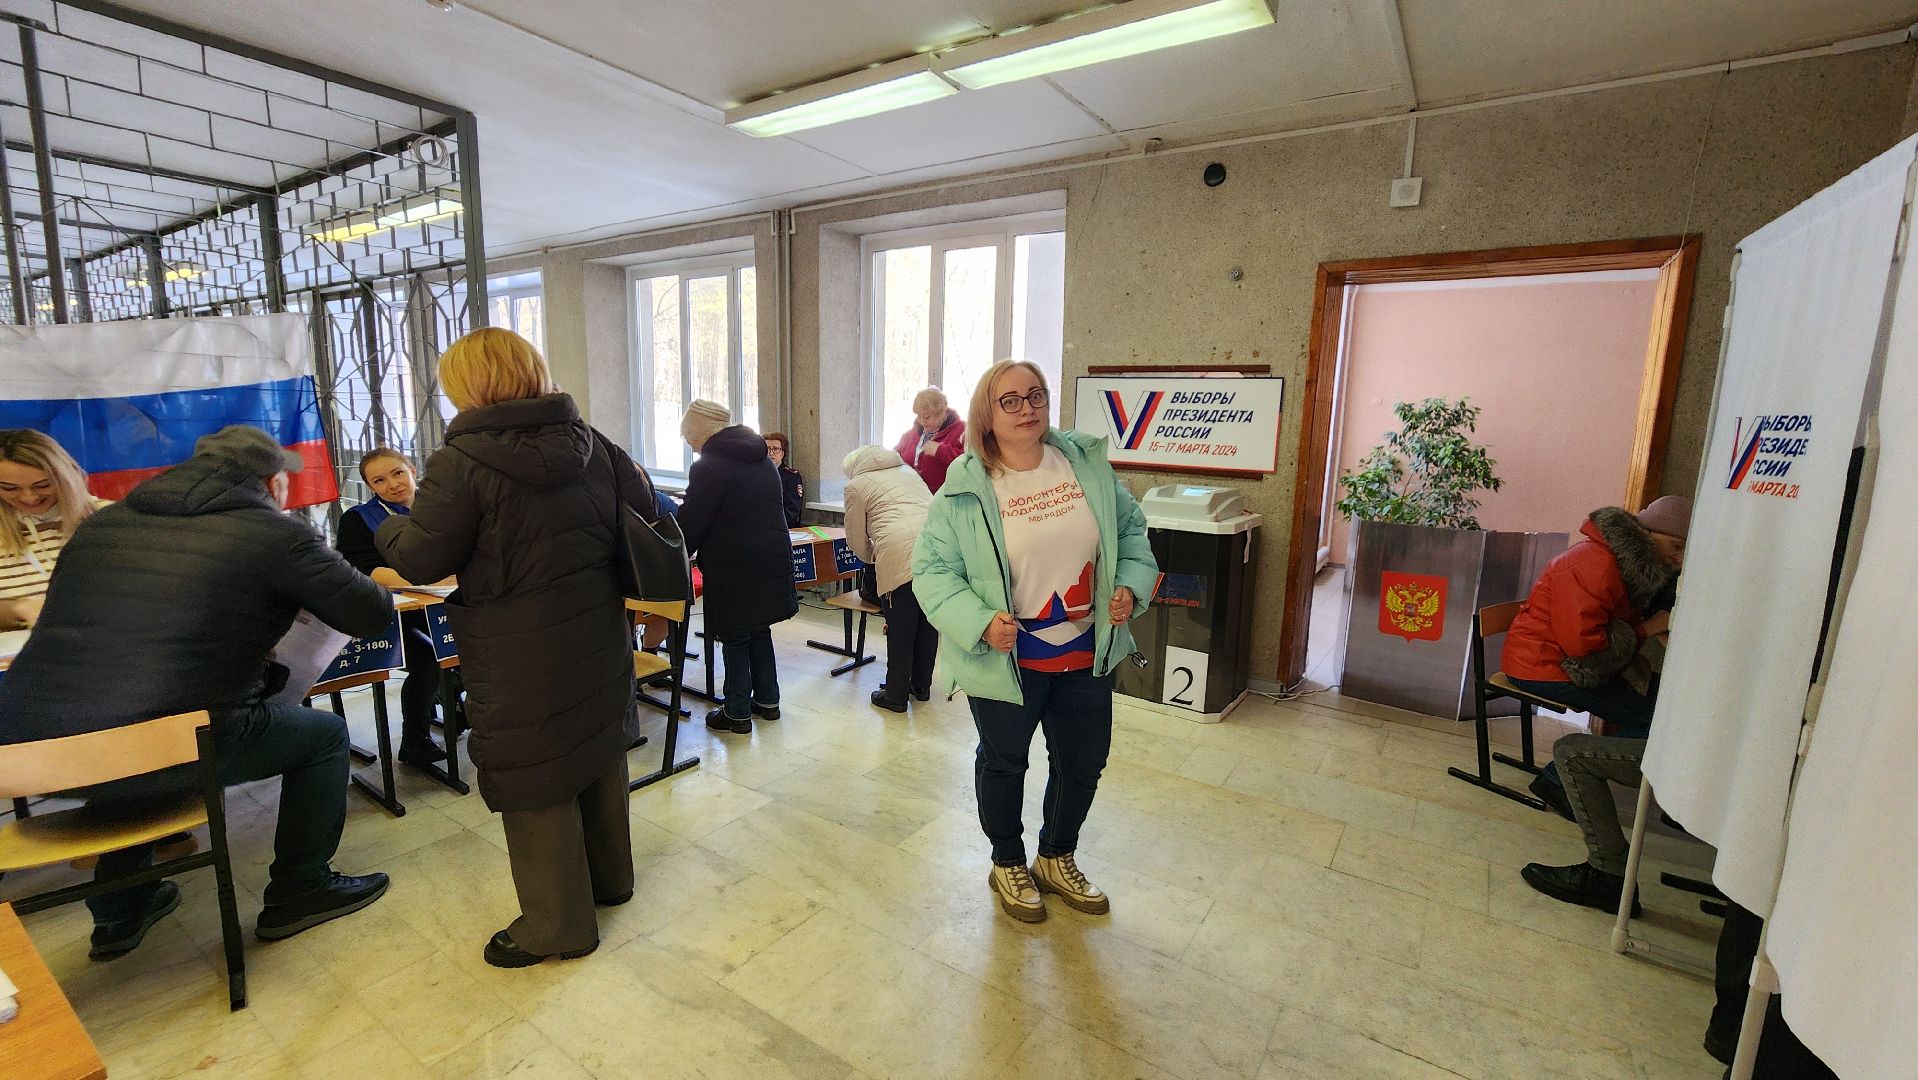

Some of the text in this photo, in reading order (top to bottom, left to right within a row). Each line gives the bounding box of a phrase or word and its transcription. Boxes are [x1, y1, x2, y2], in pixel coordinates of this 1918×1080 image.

[1170, 391, 1236, 405] ВЫБОРЫ
[1162, 408, 1254, 424] ПРЕЗИДЕНТА
[1154, 425, 1213, 440] РОССИИ
[1176, 442, 1211, 455] МАРТА
[1211, 444, 1238, 457] 2024
[1008, 480, 1078, 509] ВОЛОНТЕРЫ
[1028, 504, 1076, 523] МЫ РЯДОМ
[354, 639, 393, 653] 3-180),
[339, 655, 361, 669] д. 7
[1169, 666, 1194, 706] 2
